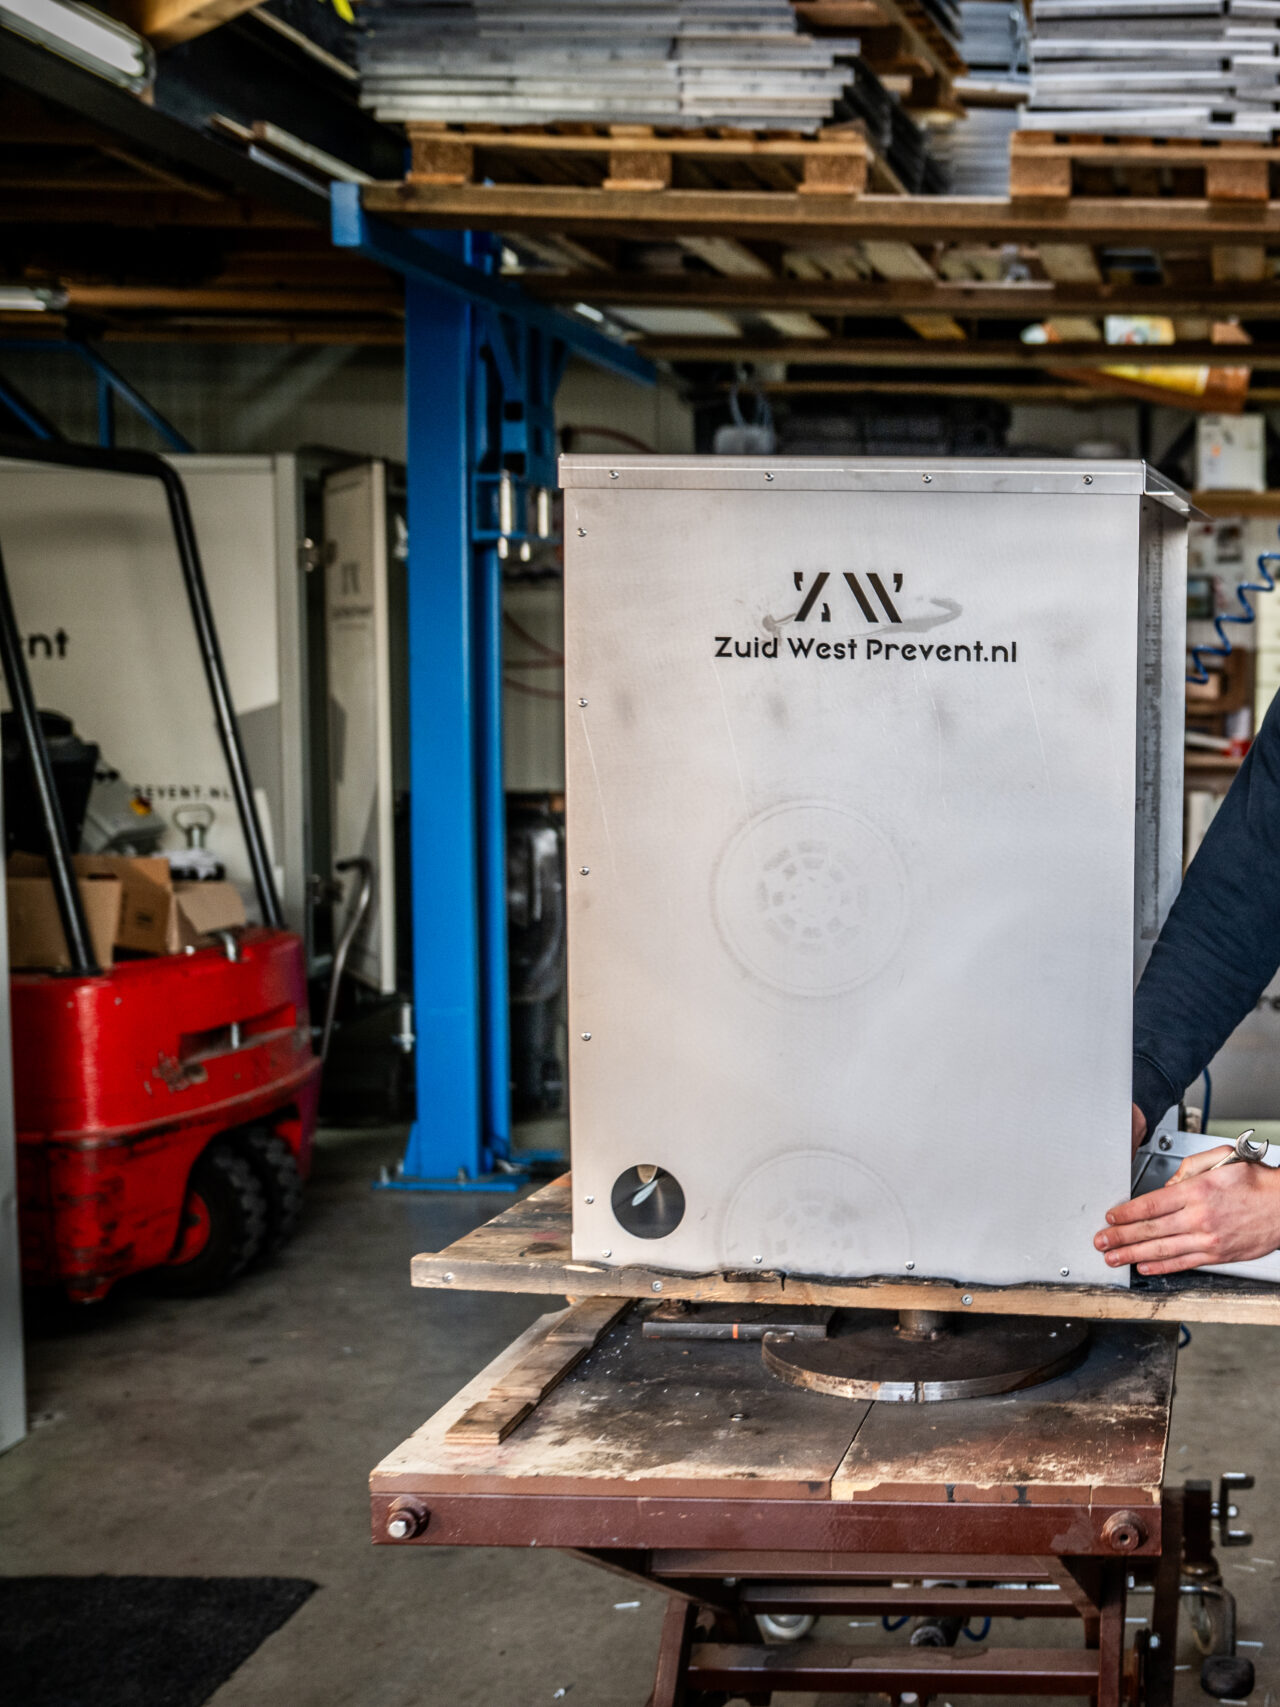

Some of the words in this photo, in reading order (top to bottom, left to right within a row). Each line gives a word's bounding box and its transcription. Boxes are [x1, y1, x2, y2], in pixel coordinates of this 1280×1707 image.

[714, 636, 779, 659] Zuid
[787, 637, 858, 660] West
[866, 638, 1017, 663] Prevent.nl
